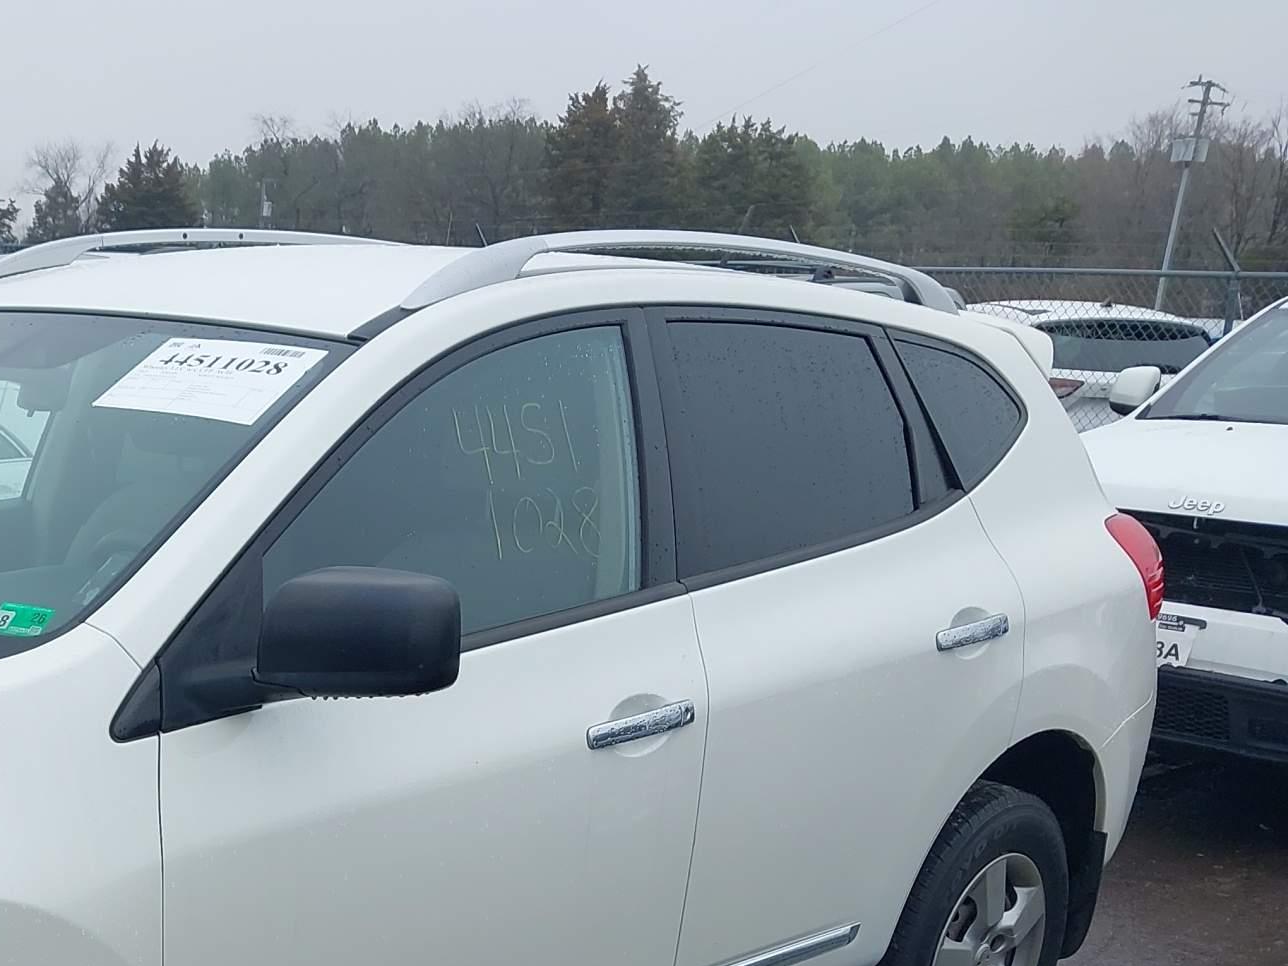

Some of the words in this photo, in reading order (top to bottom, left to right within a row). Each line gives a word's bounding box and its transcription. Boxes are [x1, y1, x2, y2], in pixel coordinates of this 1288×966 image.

[160, 352, 289, 376] 44511028
[1168, 495, 1226, 516] Jeep
[488, 485, 602, 560] 1028
[31, 612, 48, 624] 26
